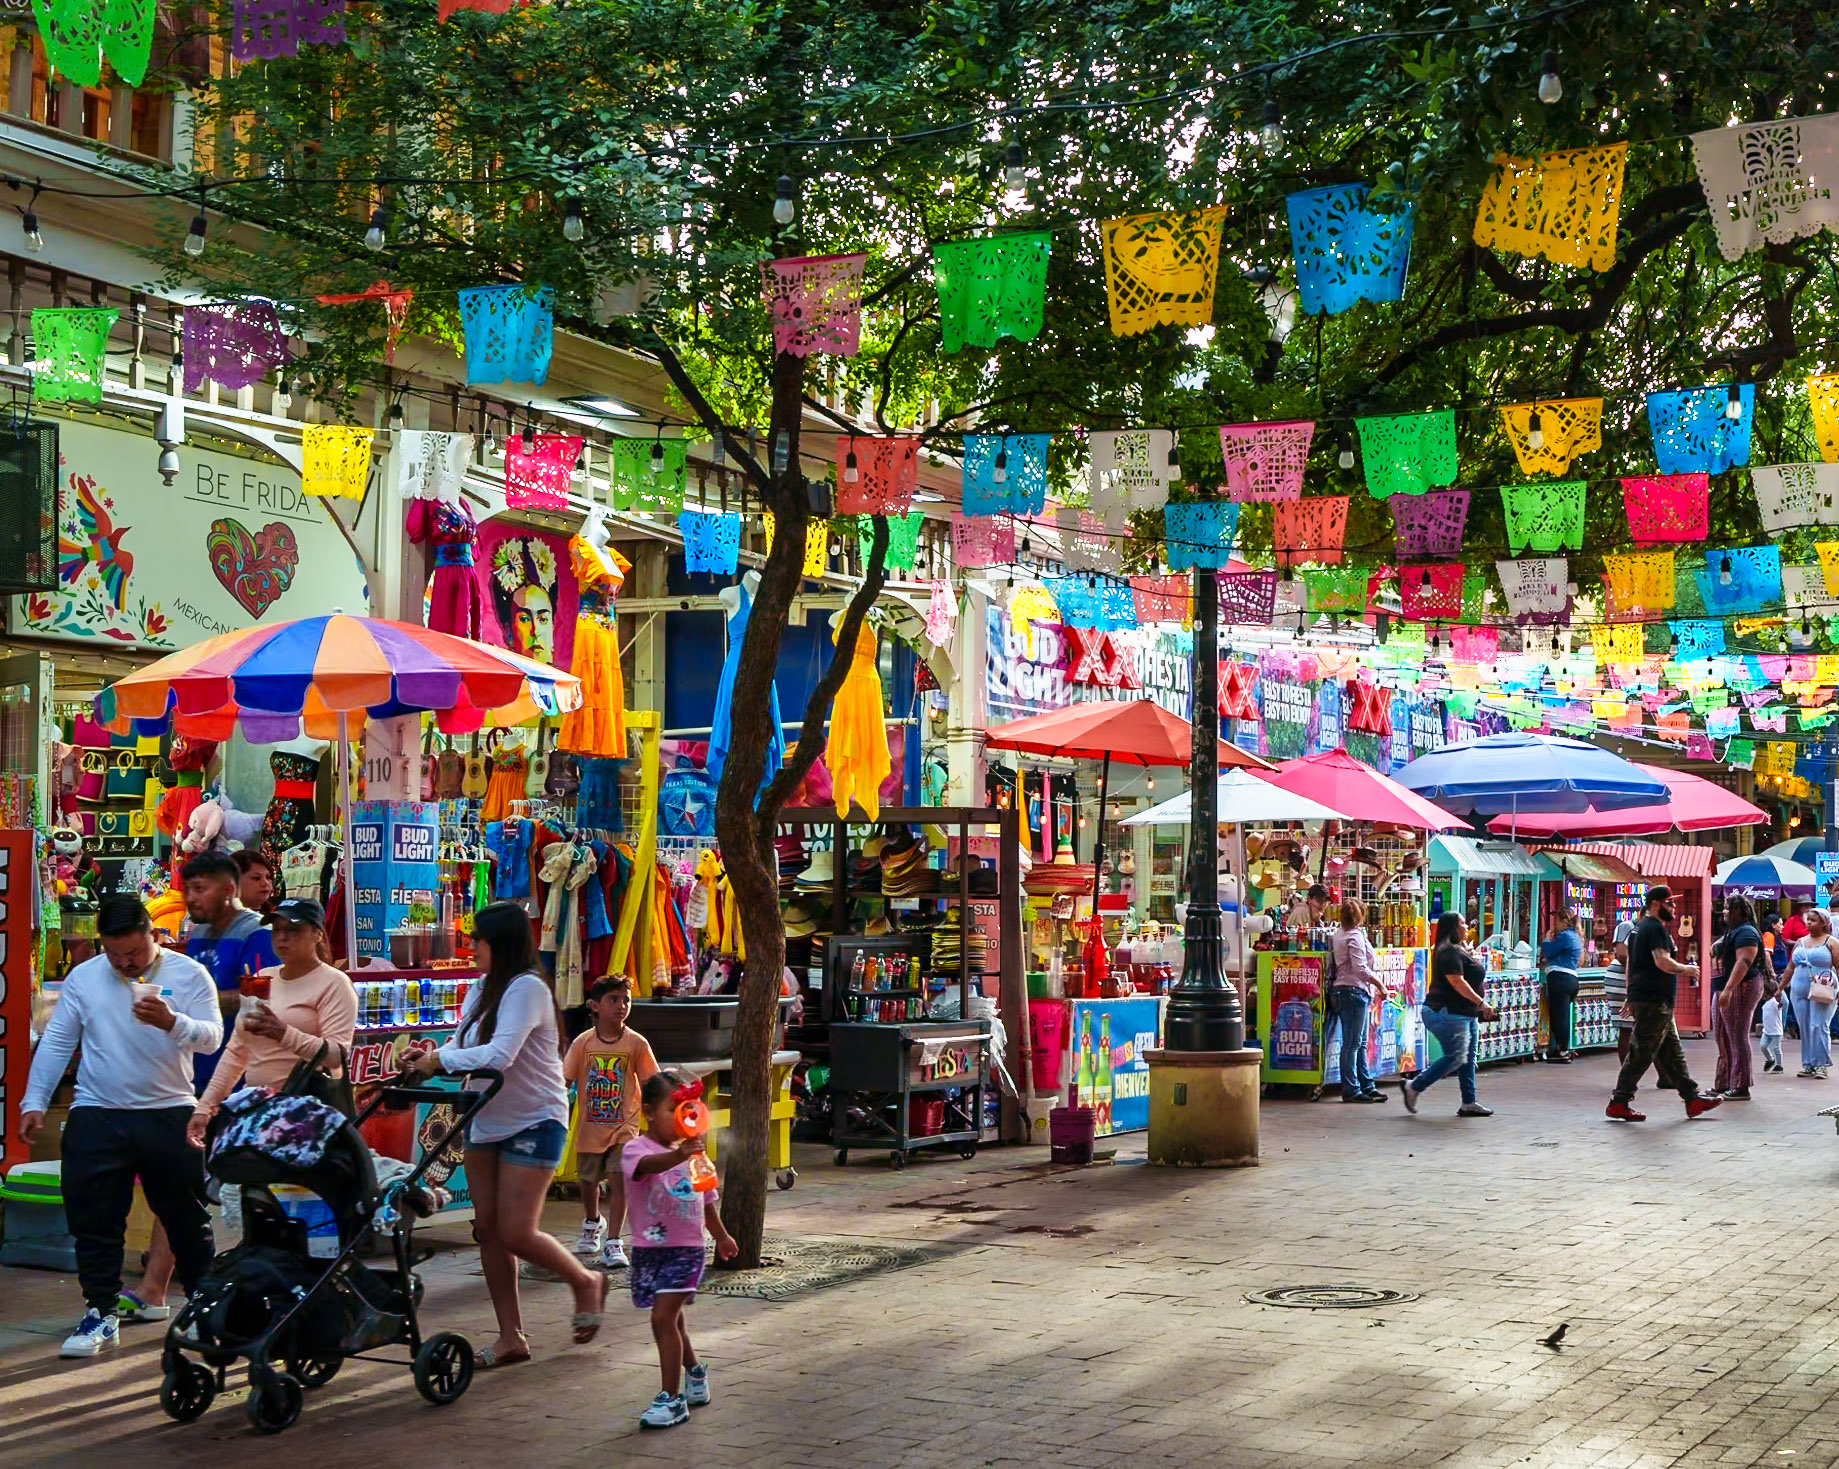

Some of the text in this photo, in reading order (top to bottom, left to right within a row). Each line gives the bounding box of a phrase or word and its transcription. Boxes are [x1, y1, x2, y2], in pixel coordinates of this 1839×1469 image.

[173, 597, 230, 635] MEXICAN
[1144, 650, 1190, 693] FIESTA
[984, 655, 1066, 706] LIGHT
[368, 756, 391, 783] 110
[355, 827, 378, 843] BUD
[401, 827, 429, 844] BUD
[394, 844, 433, 860] LIGHT
[355, 888, 382, 904] IESTA
[356, 917, 374, 930] SAN
[357, 939, 382, 952] TONIO
[431, 960, 470, 968] ONLY CASH
[1273, 967, 1319, 978] EASY TO FIESTA
[1273, 975, 1318, 985] EASY TO ENJOY
[1279, 1030, 1308, 1043] BUD
[1381, 1030, 1396, 1044] BUD
[1276, 1042, 1312, 1056] LIGHT
